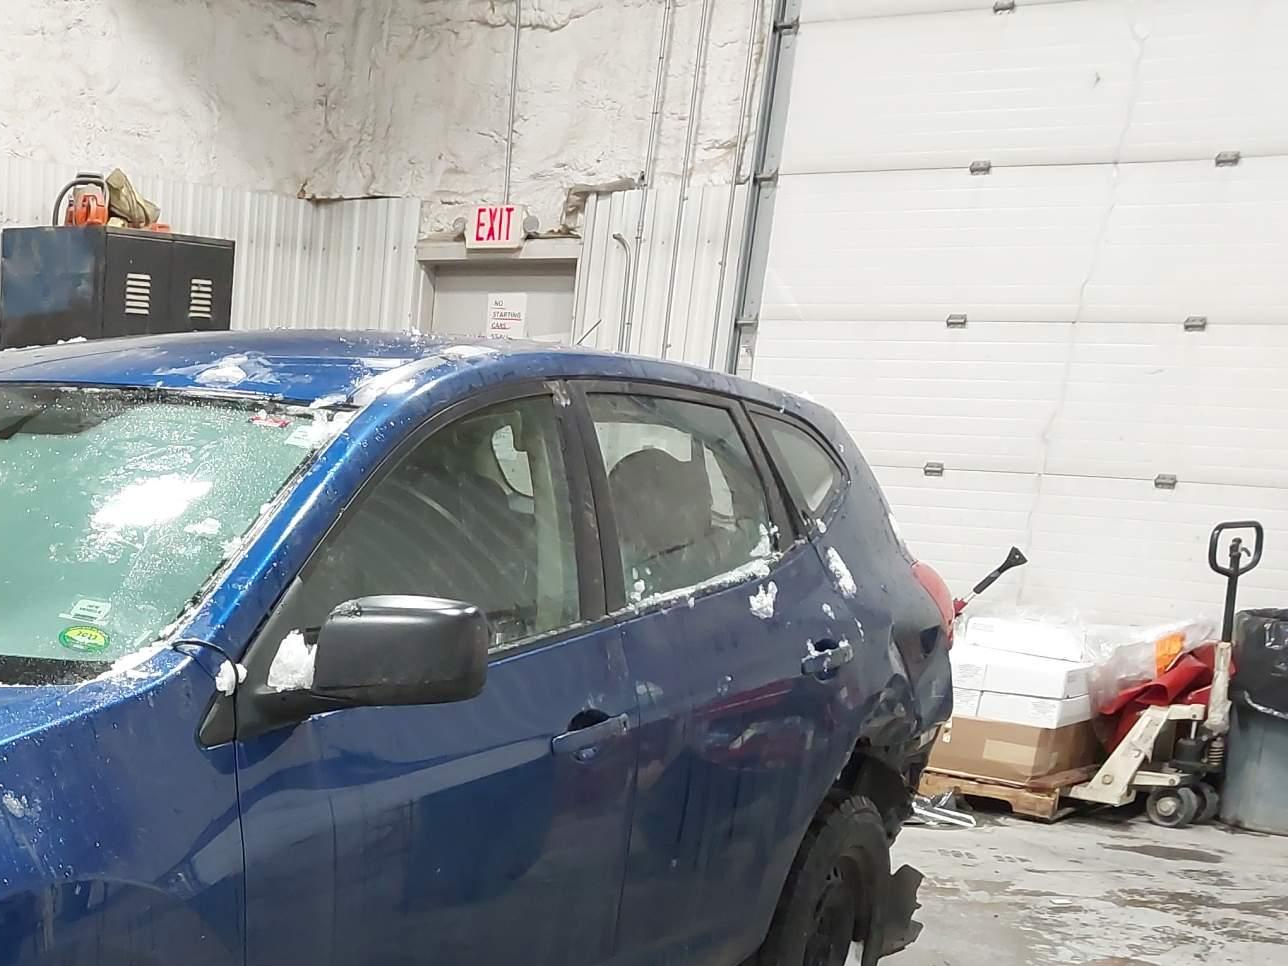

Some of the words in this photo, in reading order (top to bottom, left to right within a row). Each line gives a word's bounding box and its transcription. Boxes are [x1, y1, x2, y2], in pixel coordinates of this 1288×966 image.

[475, 207, 515, 242] EXIT
[494, 299, 504, 307] NO
[492, 311, 522, 319] STARTING
